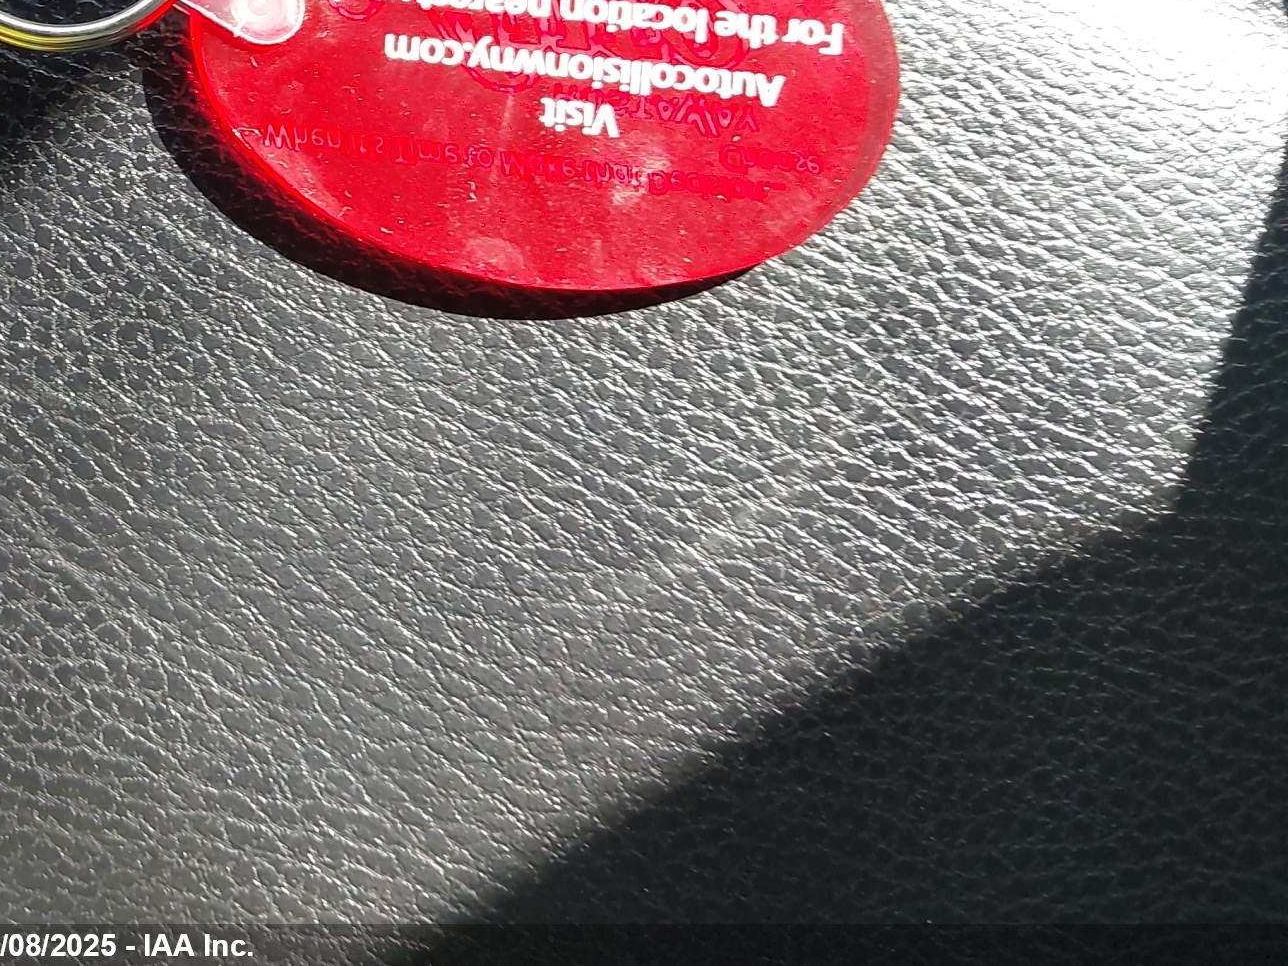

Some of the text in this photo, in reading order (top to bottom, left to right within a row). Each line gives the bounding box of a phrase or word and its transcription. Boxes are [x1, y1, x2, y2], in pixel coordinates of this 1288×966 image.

[714, 9, 778, 49] the
[781, 17, 845, 55] For
[384, 33, 786, 107] Autocollisionwny.com
[538, 96, 620, 138] Visit
